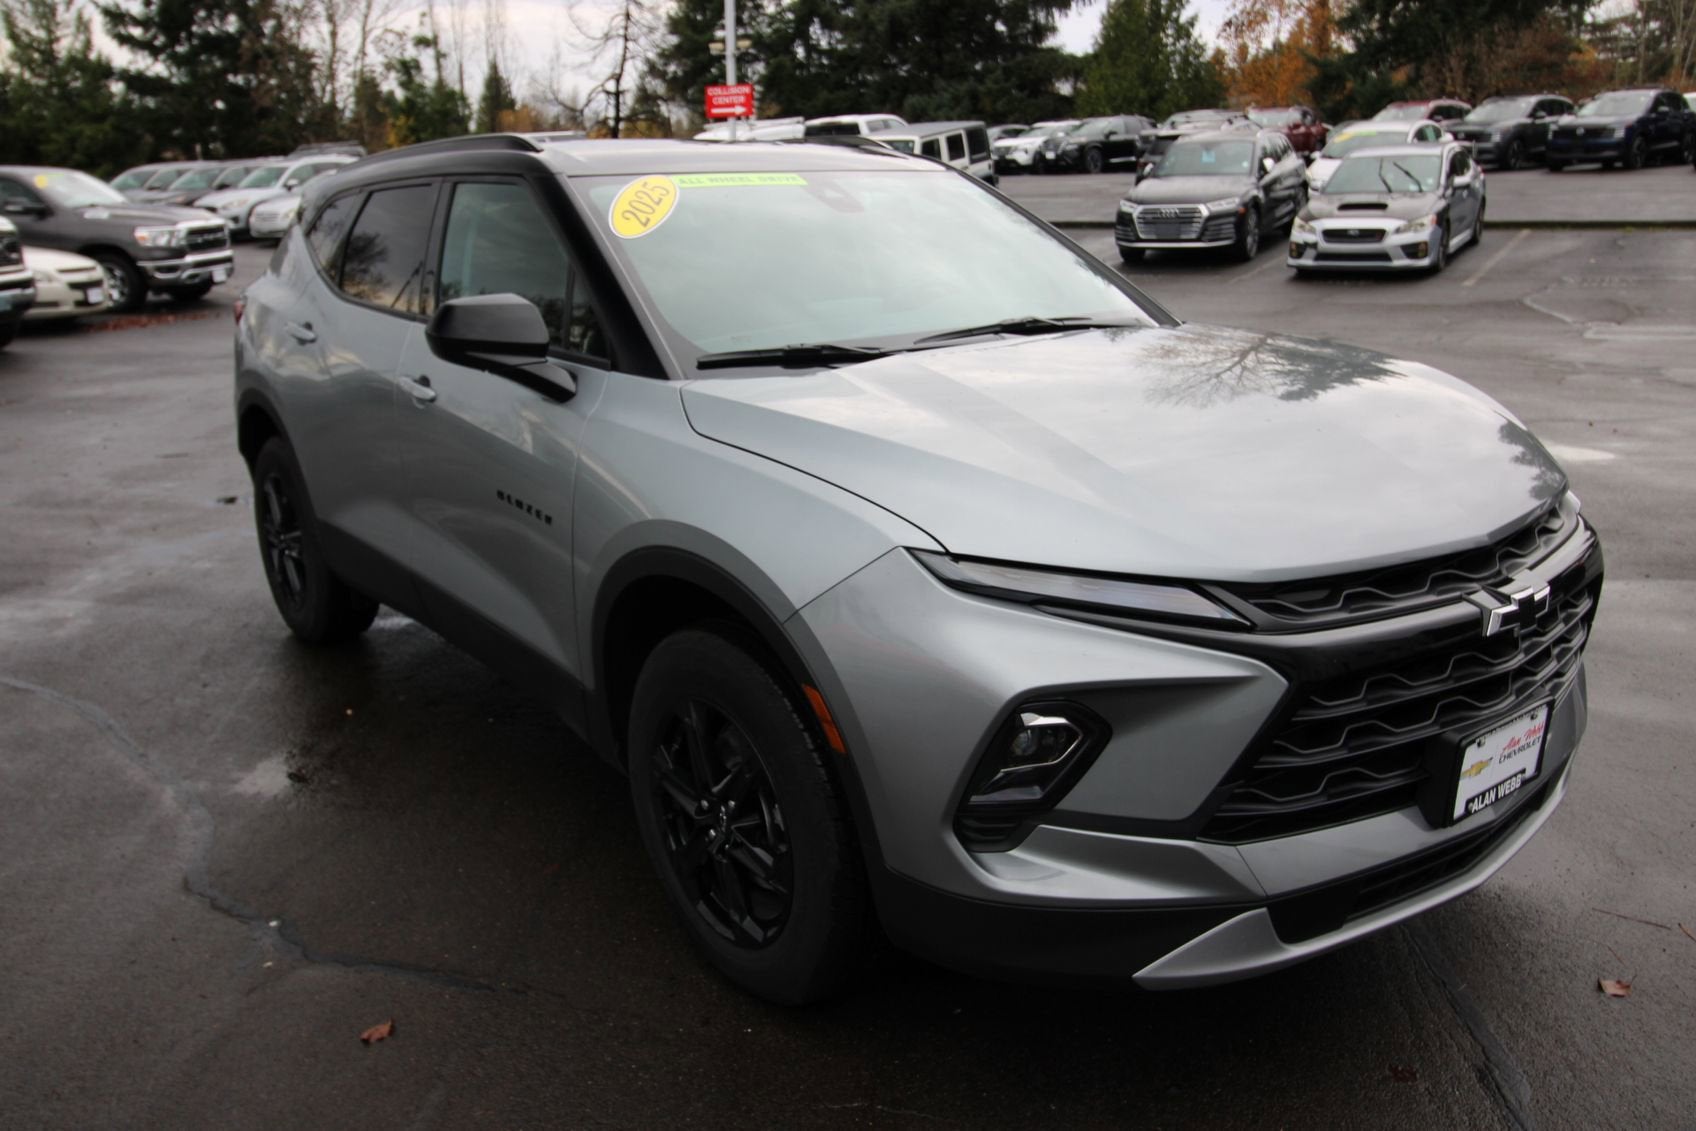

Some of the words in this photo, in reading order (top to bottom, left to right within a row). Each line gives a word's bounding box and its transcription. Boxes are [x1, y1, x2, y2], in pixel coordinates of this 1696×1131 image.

[707, 86, 751, 96] COLLISION
[712, 95, 745, 105] CENTER
[678, 177, 705, 185] ALL
[708, 176, 755, 184] WHEEL
[621, 181, 670, 228] 2025
[496, 489, 553, 526] BLAZER
[1498, 735, 1542, 764] CHEVROLET
[1471, 787, 1497, 814] ALAN
[1497, 773, 1522, 800] WEBB
